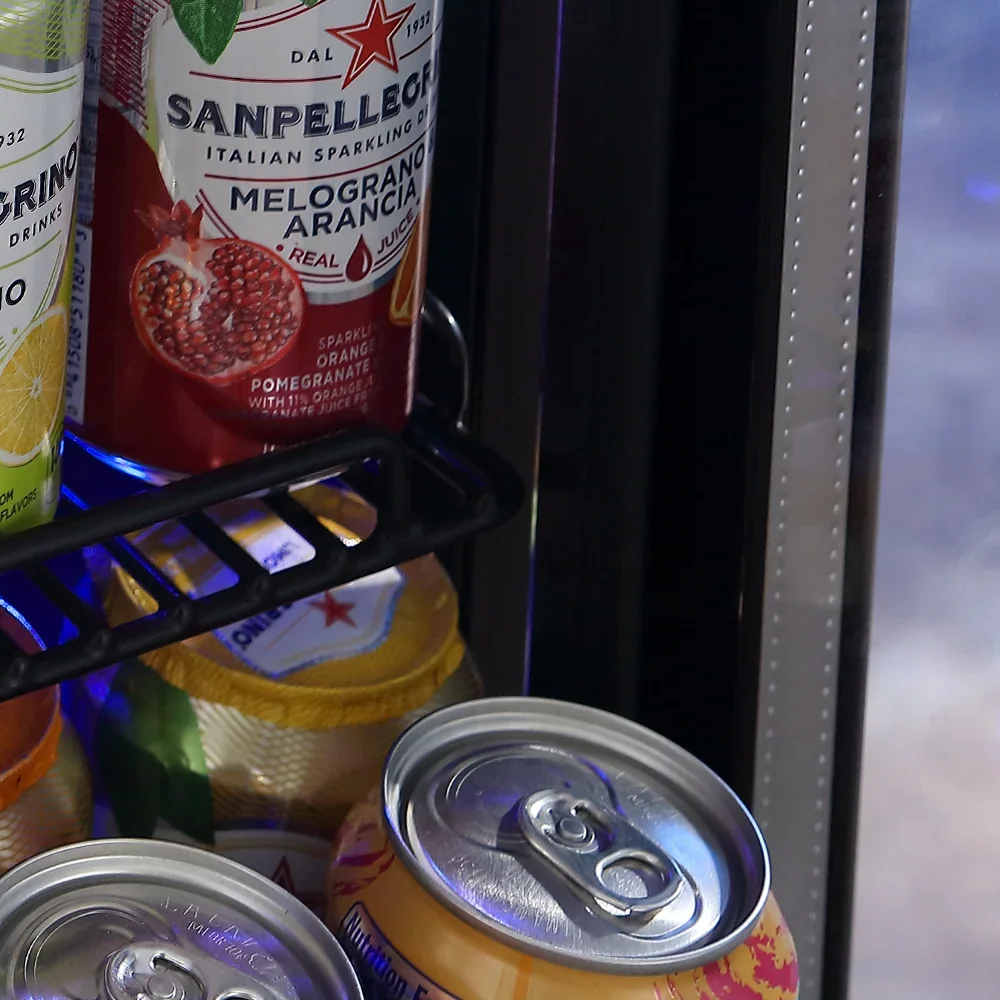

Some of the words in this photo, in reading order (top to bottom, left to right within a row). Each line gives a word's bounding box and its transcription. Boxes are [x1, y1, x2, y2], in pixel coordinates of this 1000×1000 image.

[290, 47, 335, 64] DAL
[405, 10, 432, 39] 1932
[206, 146, 302, 165] ITALIAN
[314, 122, 413, 163] SPARKLING
[229, 143, 426, 213] MELOGRANO
[9, 205, 64, 249] DRINKS
[282, 180, 417, 240] ARANCIA
[288, 246, 340, 269] REAL
[376, 211, 414, 255] JUICE
[251, 358, 371, 393] POMEGRANATE
[248, 395, 286, 409] WITH
[0, 487, 39, 523] FLAVORS
